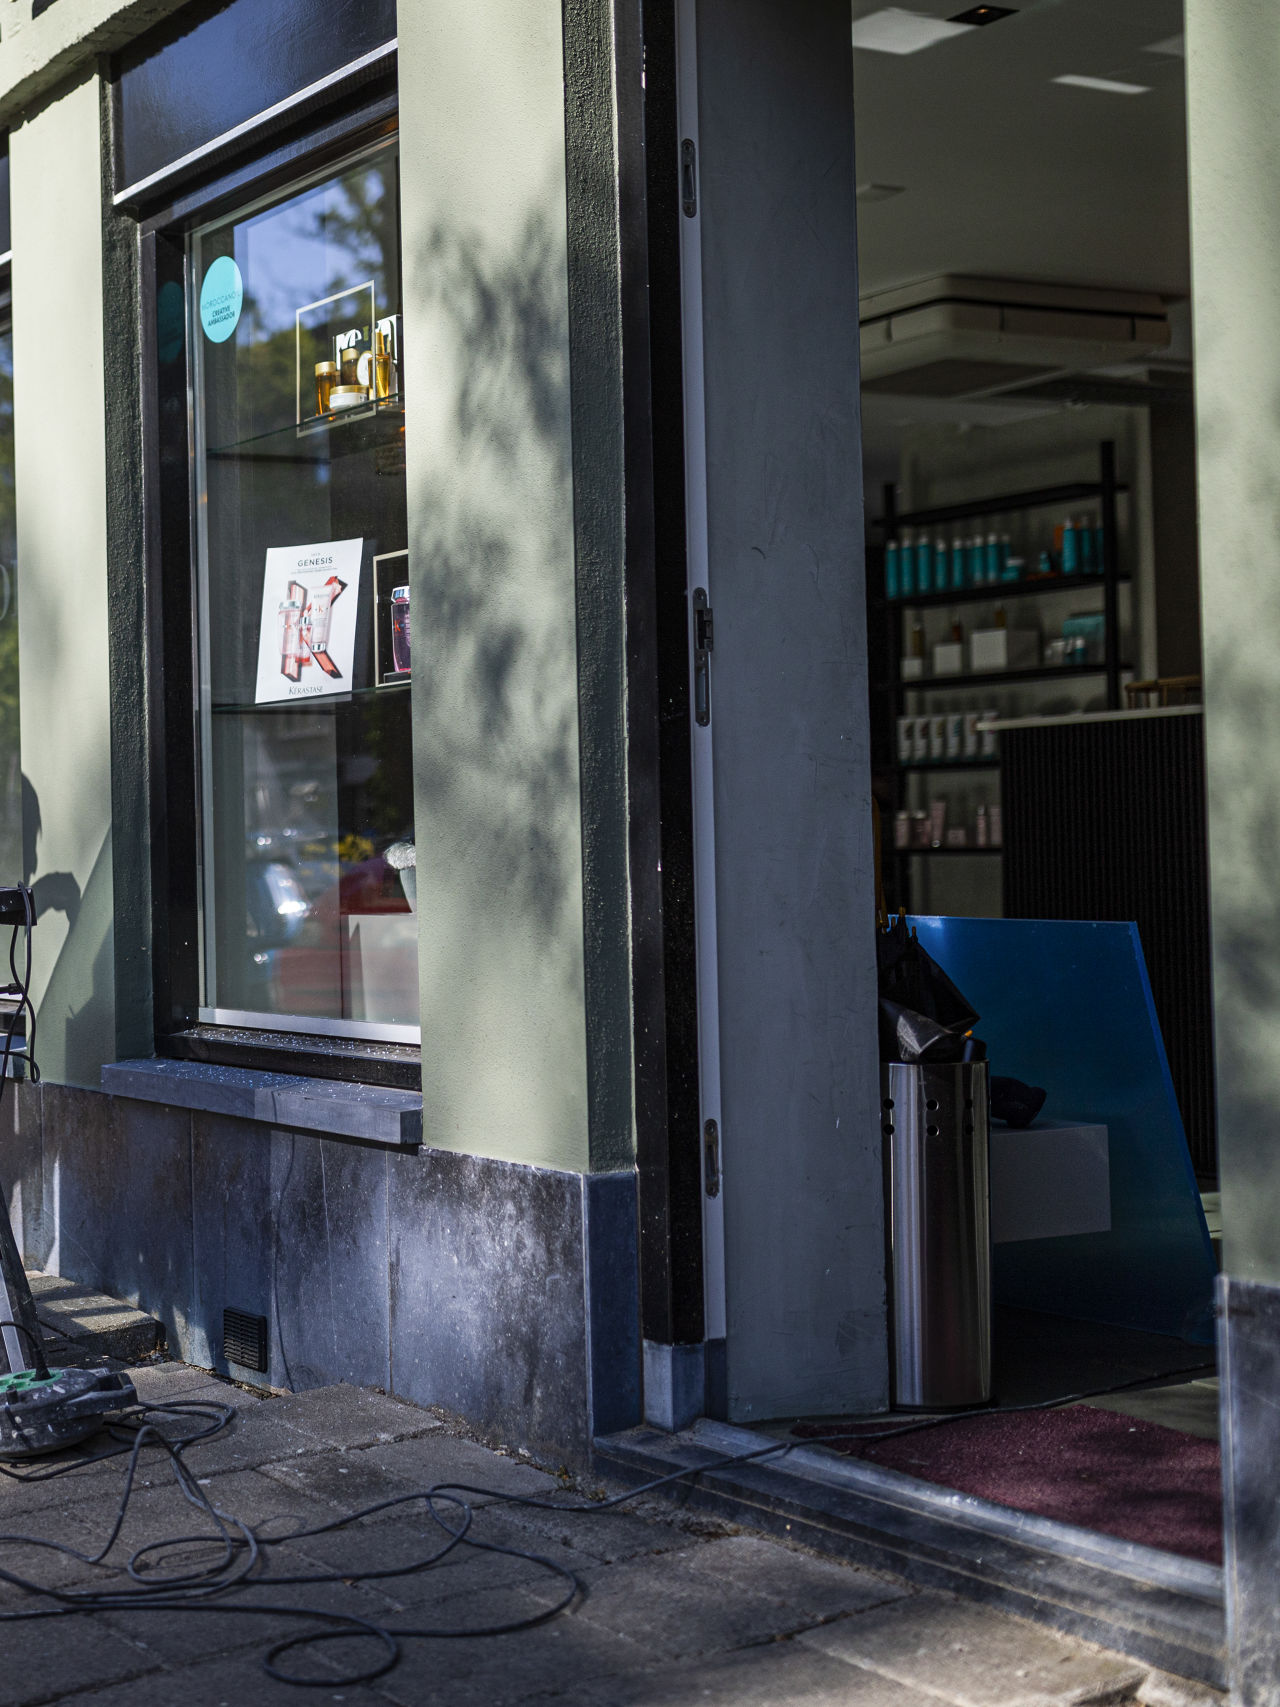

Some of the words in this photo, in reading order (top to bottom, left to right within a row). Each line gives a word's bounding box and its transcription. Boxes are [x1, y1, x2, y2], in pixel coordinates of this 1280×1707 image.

[212, 305, 231, 318] CREATIVE
[207, 310, 235, 327] AMBASSADOR
[297, 556, 333, 567] GENESIS
